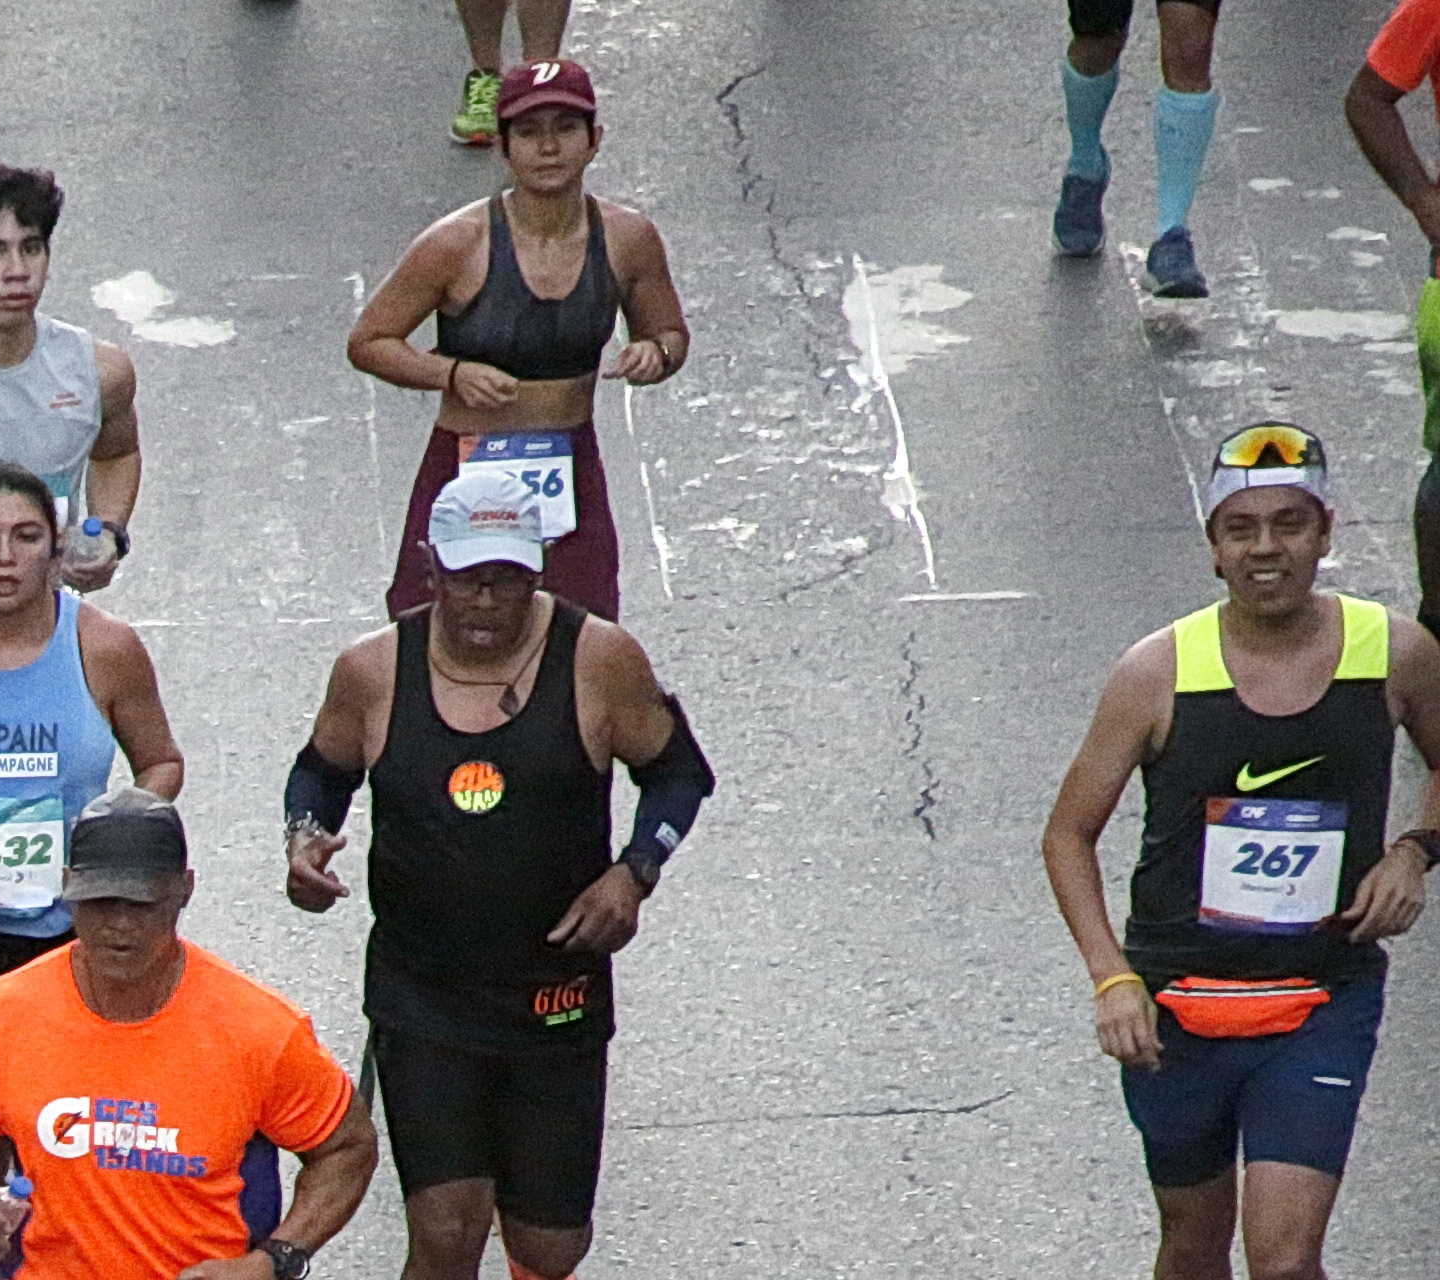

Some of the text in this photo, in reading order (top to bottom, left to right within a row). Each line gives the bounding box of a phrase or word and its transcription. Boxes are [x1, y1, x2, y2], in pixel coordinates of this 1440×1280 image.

[504, 467, 565, 498] 56
[1230, 841, 1322, 879] 267
[93, 1122, 180, 1153] ROCK
